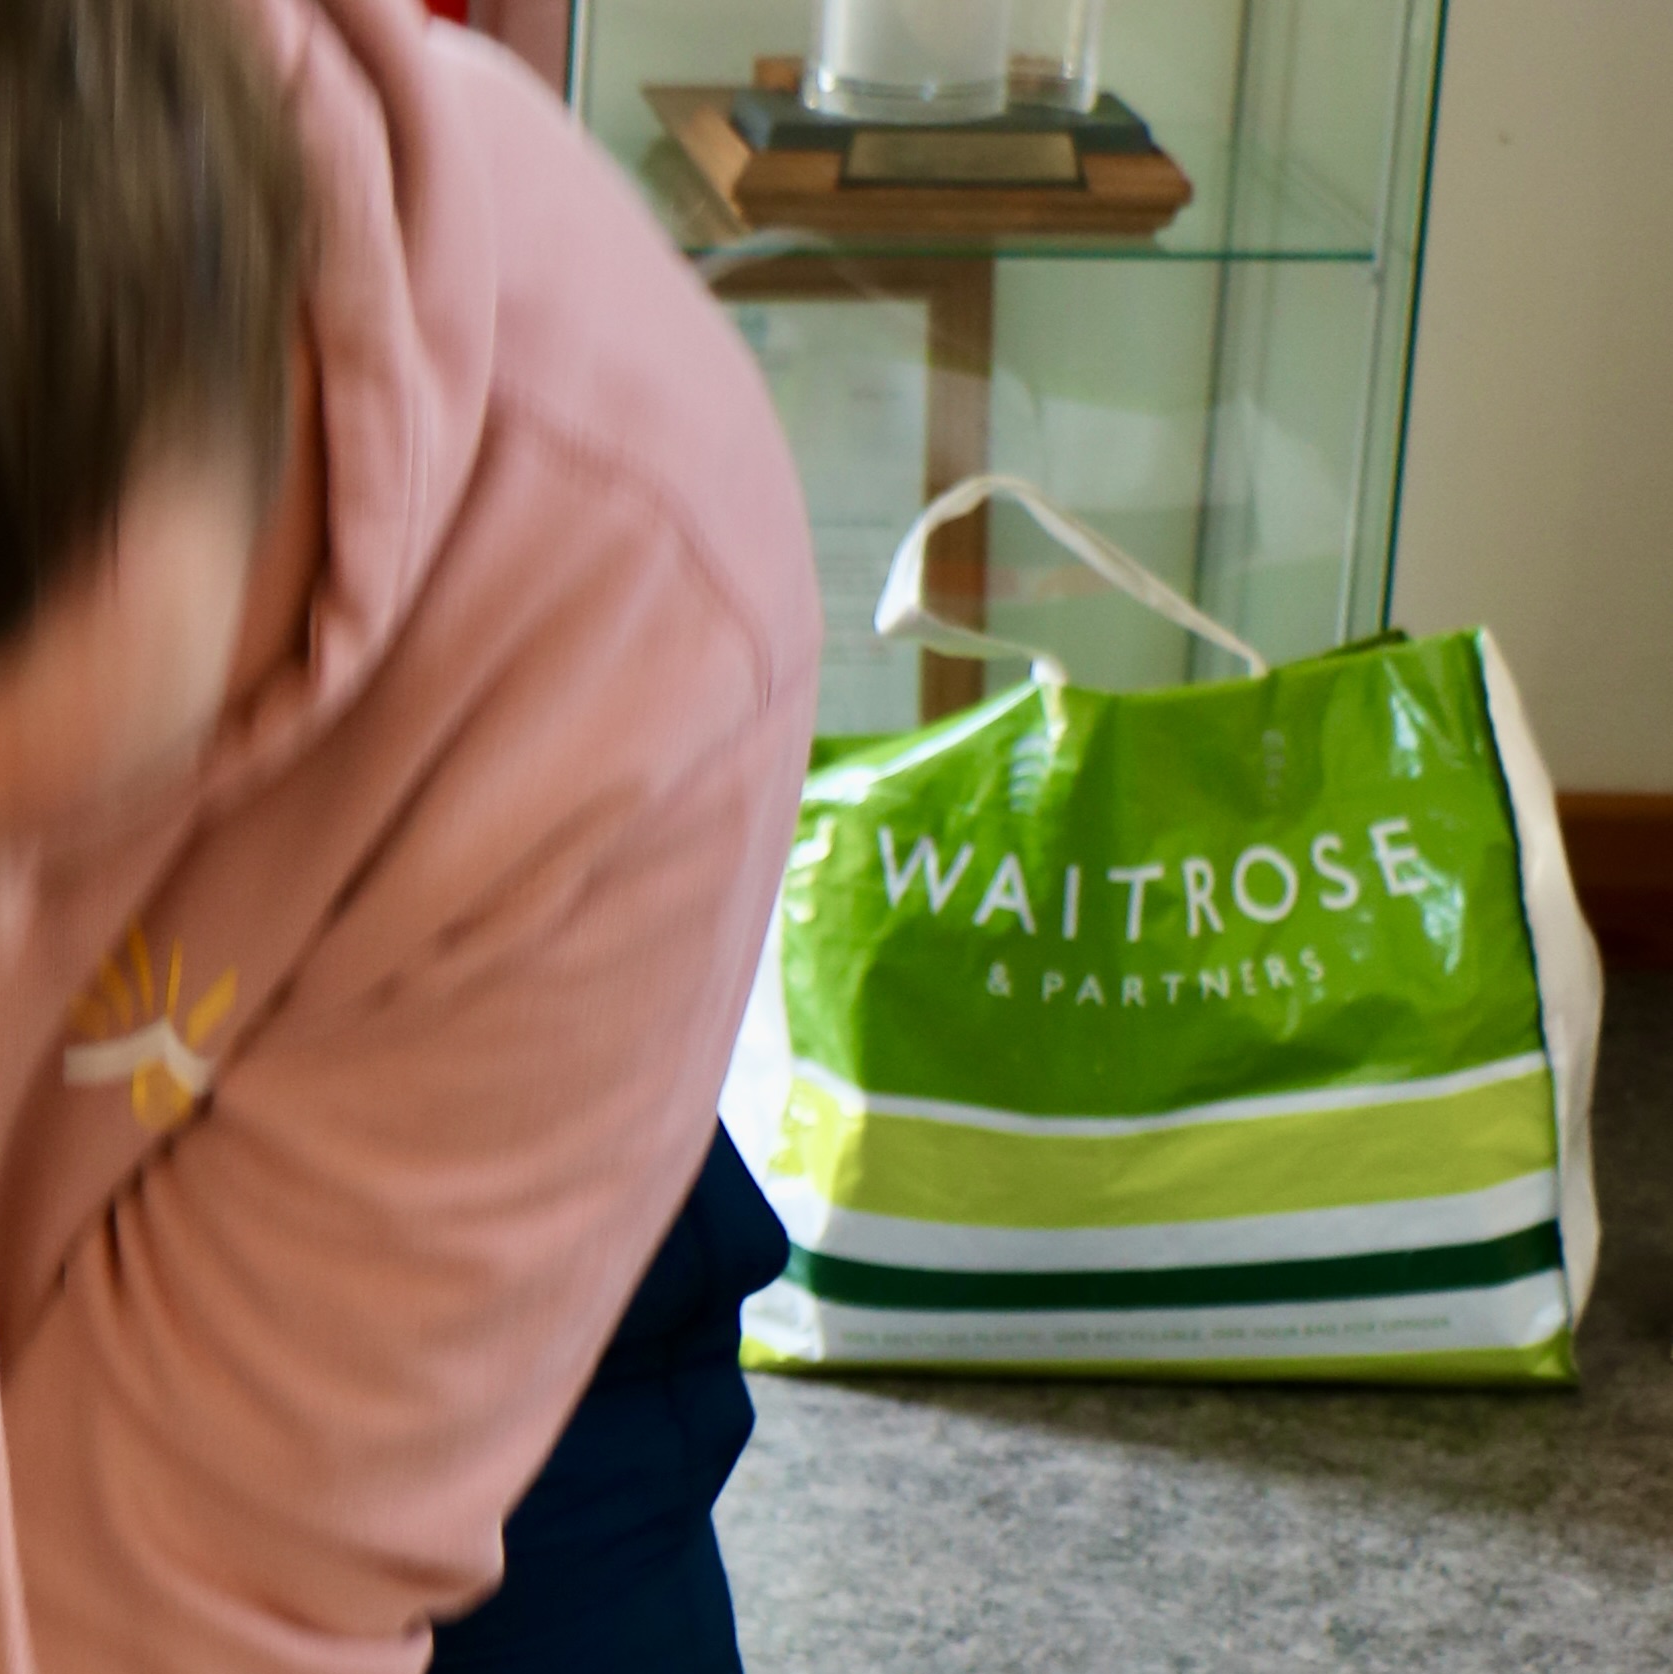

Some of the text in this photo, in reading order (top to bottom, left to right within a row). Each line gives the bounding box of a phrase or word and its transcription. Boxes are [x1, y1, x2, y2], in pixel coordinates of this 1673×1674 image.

[877, 817, 1428, 943] WAITROSE
[986, 947, 1325, 1008] & PARTNERS
